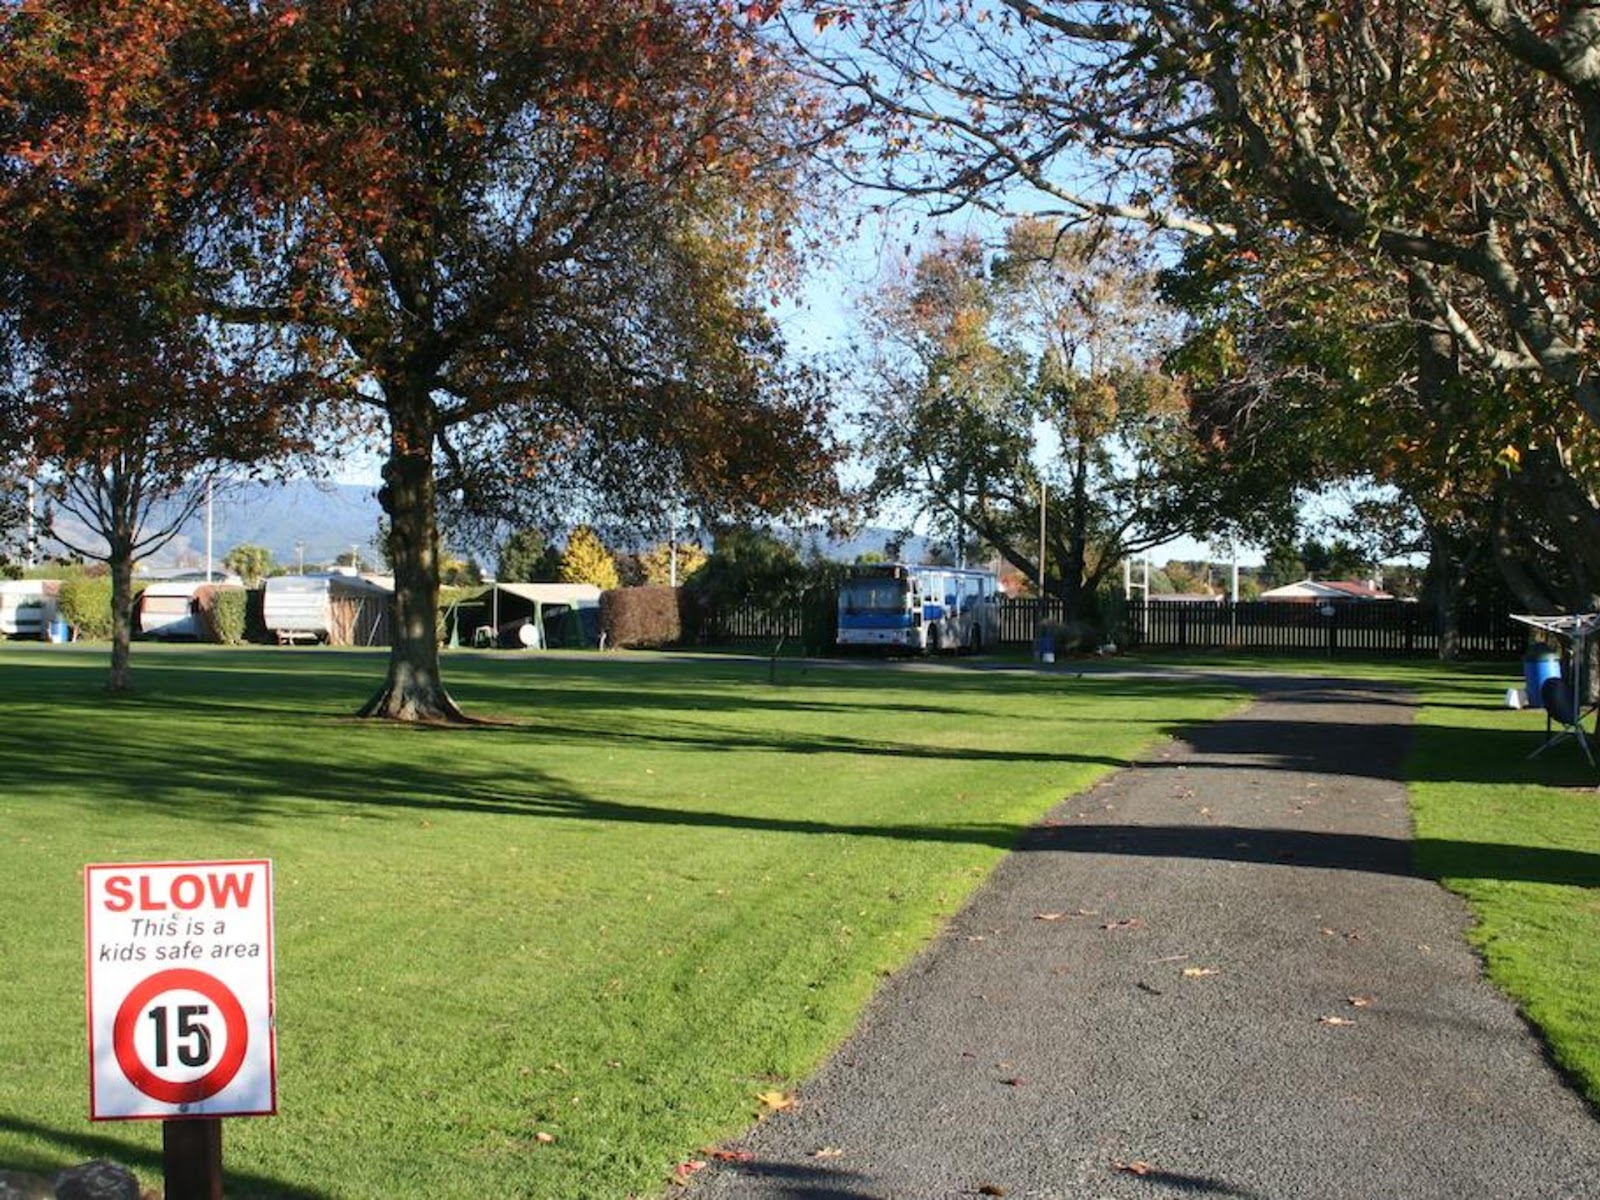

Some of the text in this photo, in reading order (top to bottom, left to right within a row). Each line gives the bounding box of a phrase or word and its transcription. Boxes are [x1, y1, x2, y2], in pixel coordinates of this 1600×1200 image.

[103, 873, 254, 912] SLOW
[131, 917, 225, 937] This is a
[100, 941, 260, 962] kids safe area
[148, 1005, 212, 1067] 15
